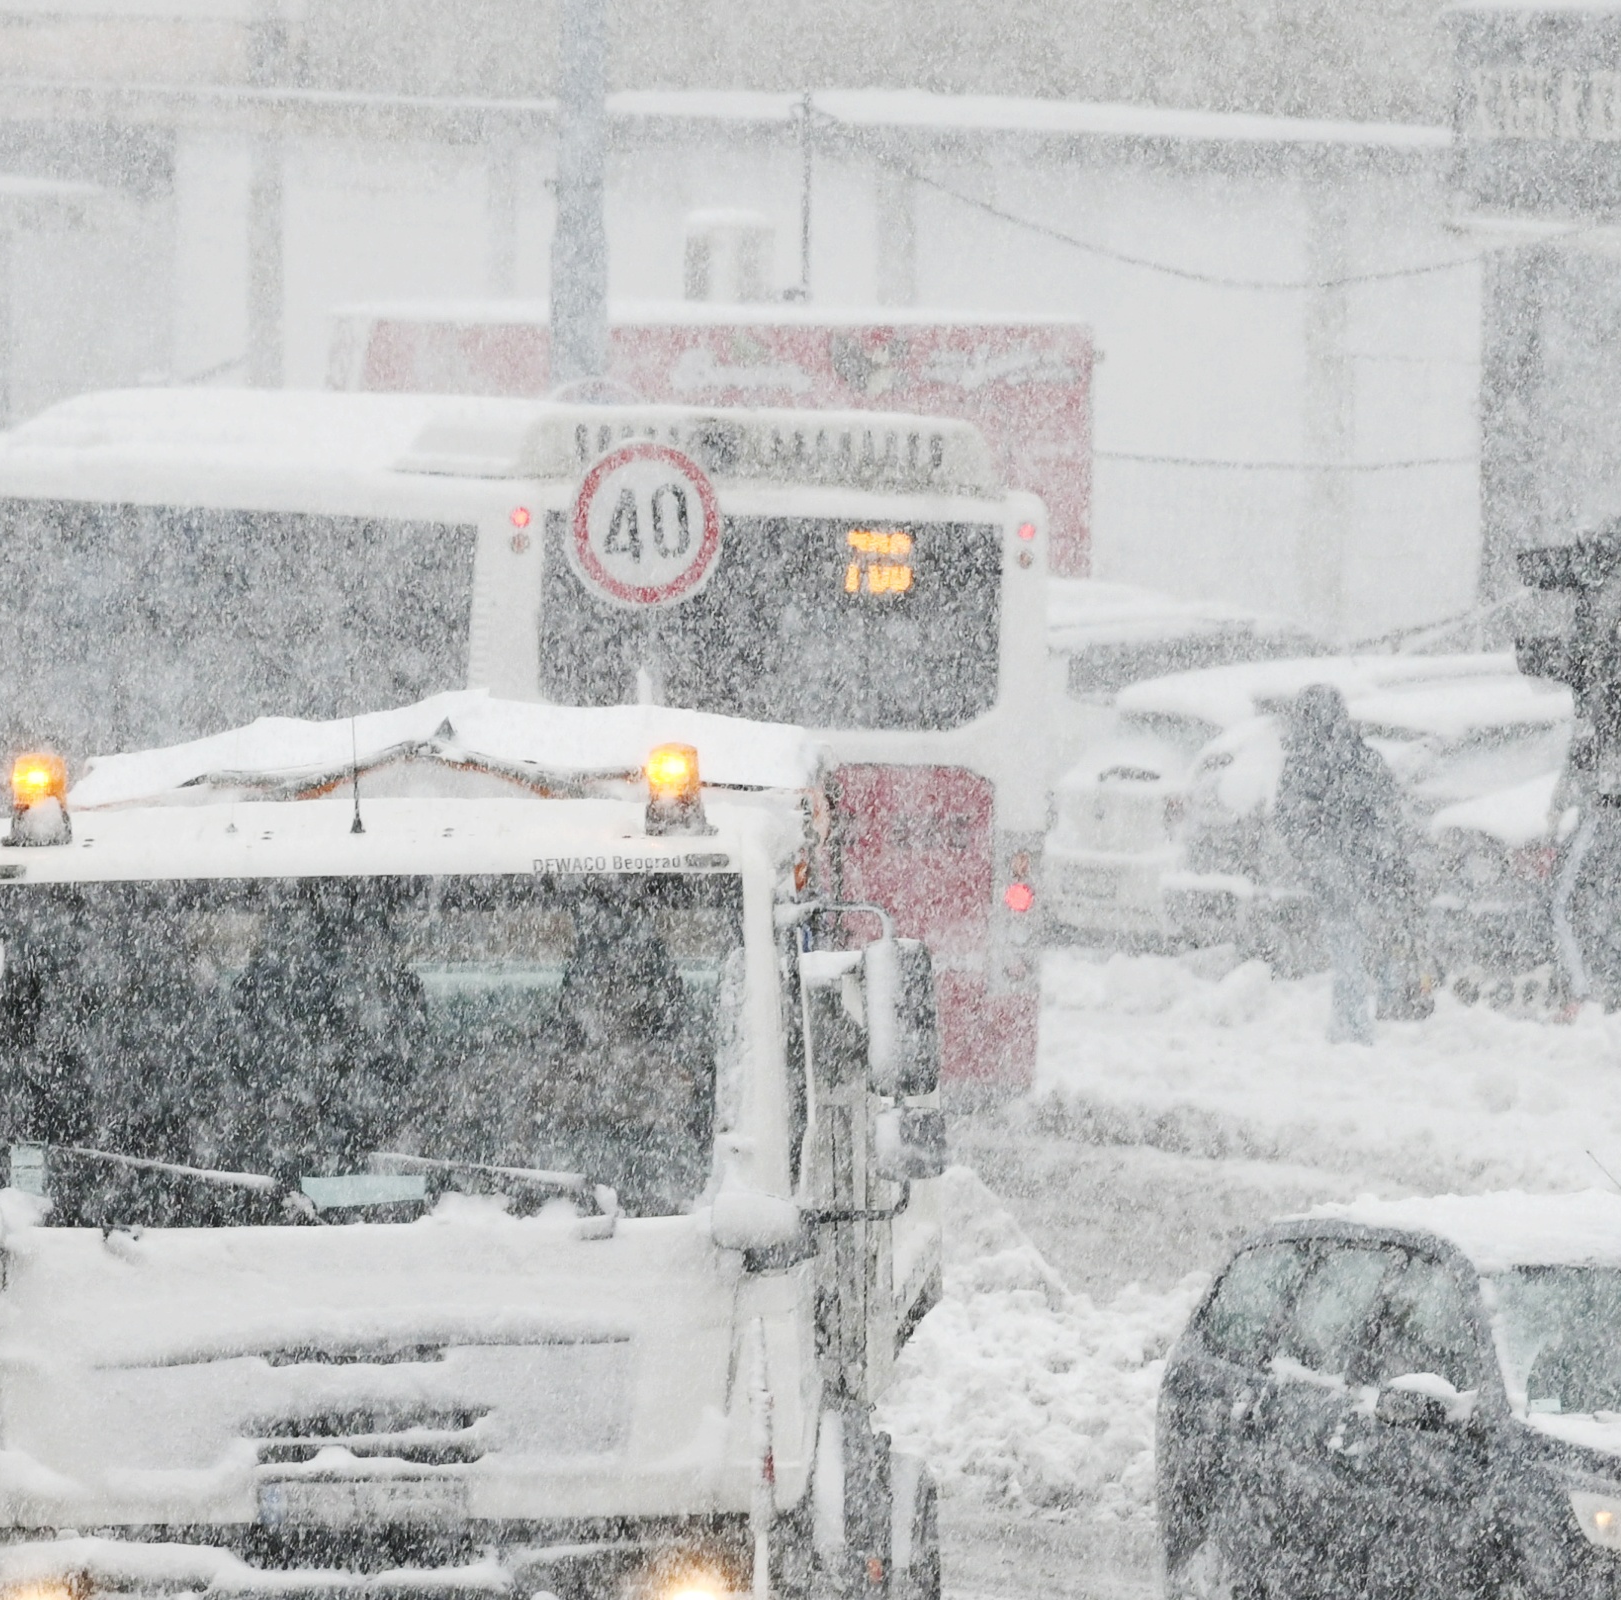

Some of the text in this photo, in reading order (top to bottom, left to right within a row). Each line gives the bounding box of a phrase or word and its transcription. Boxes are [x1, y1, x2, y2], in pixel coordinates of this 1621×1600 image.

[603, 482, 691, 564] 40
[532, 855, 682, 874] DEWACO Beograd
